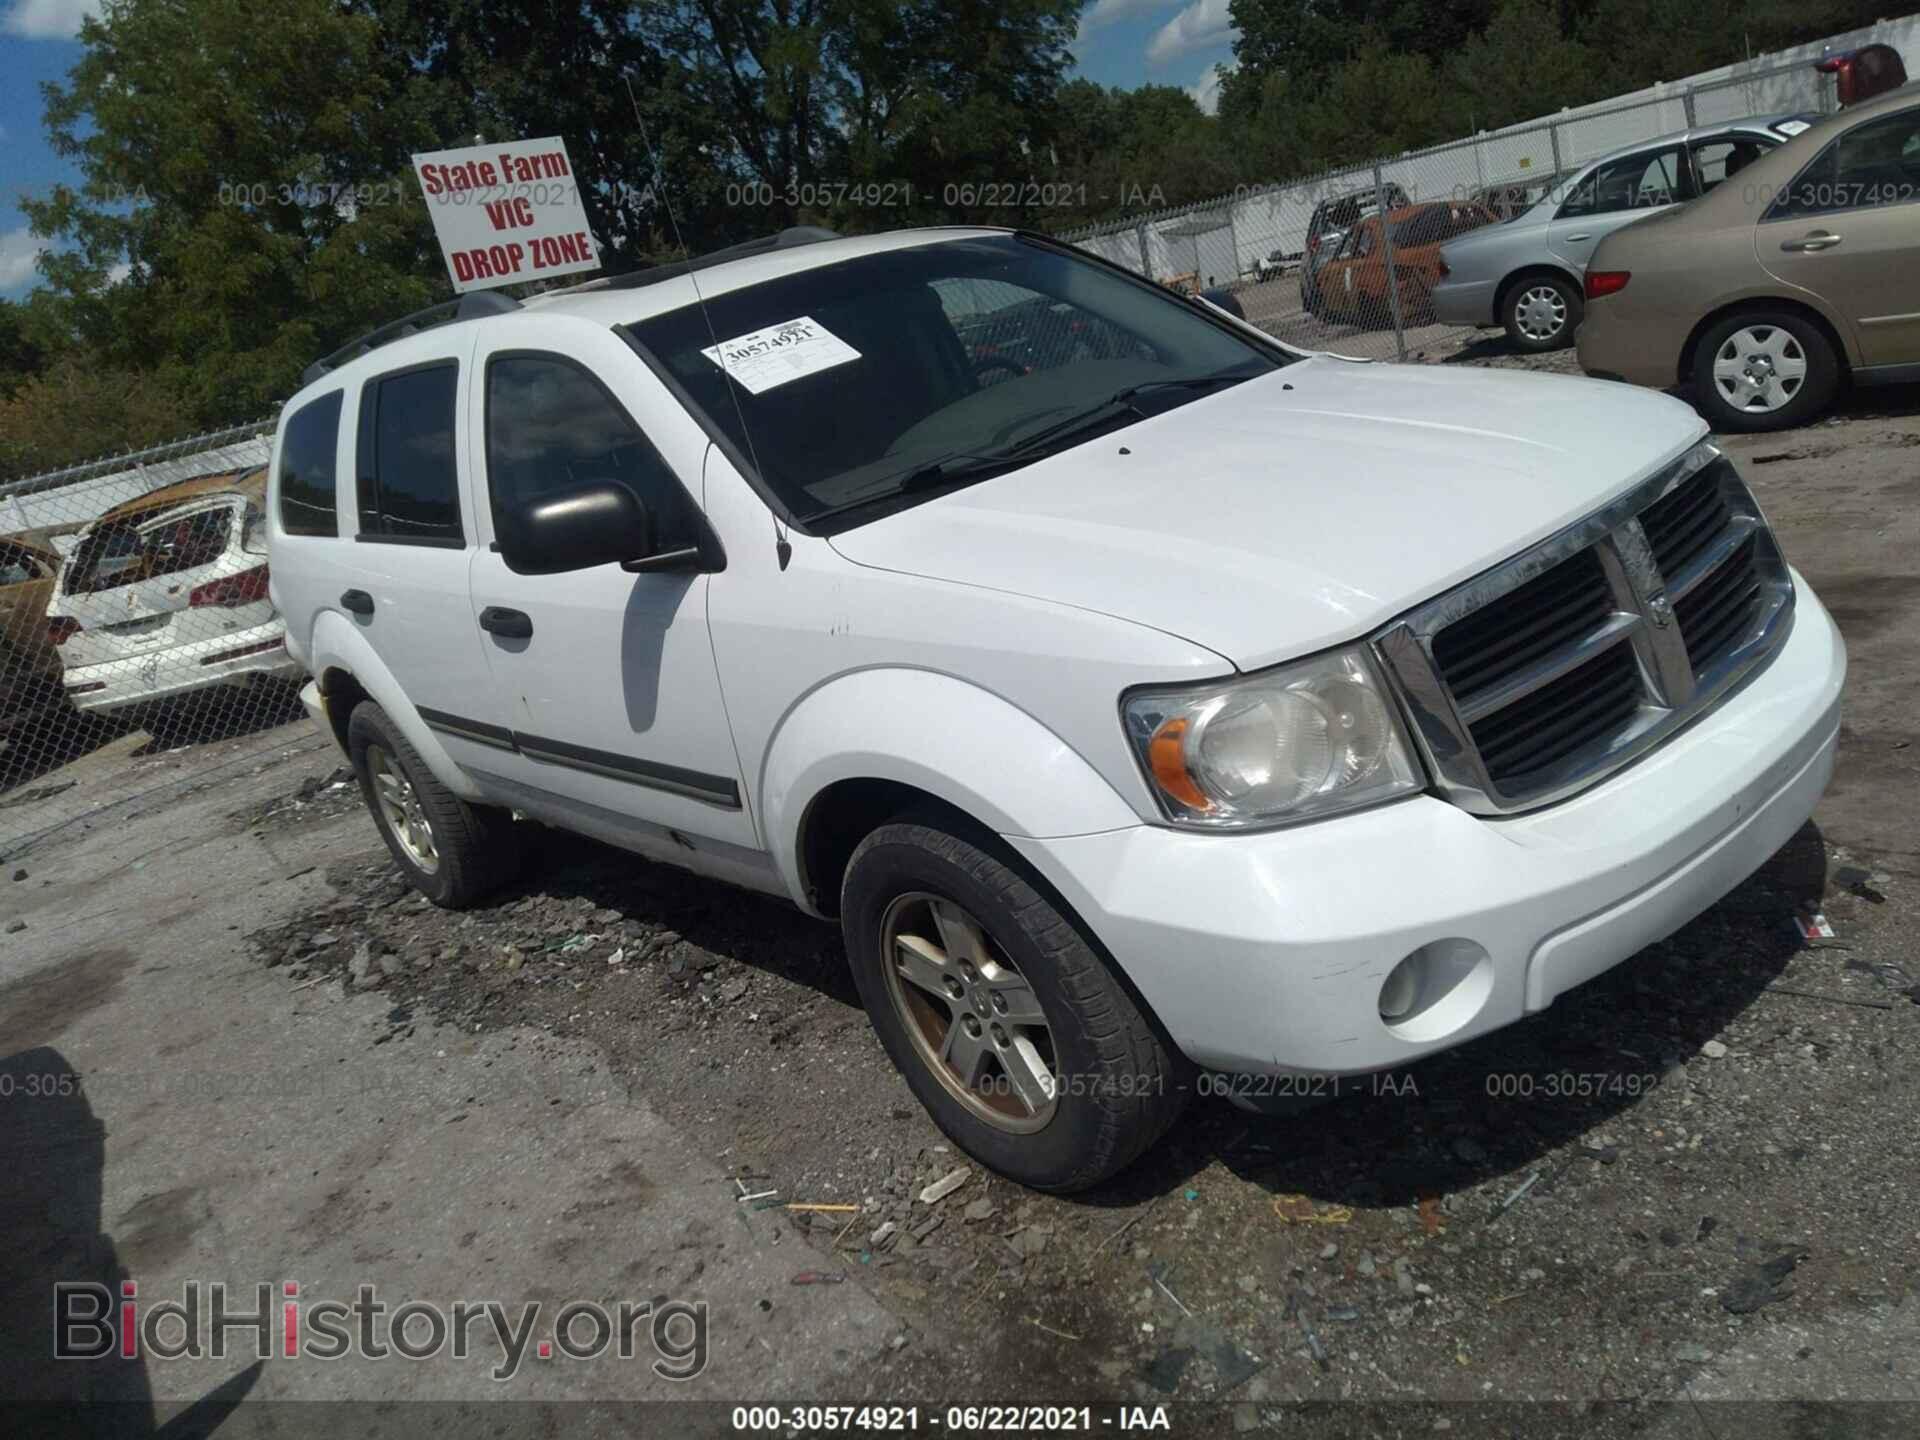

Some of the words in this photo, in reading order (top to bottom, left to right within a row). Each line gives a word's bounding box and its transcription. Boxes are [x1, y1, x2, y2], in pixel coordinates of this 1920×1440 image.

[420, 161, 498, 195] State
[498, 152, 569, 184] Farm
[484, 196, 535, 231] VIC
[451, 243, 525, 282] DROP
[527, 232, 593, 269] ZONE
[726, 325, 813, 363] 30574921
